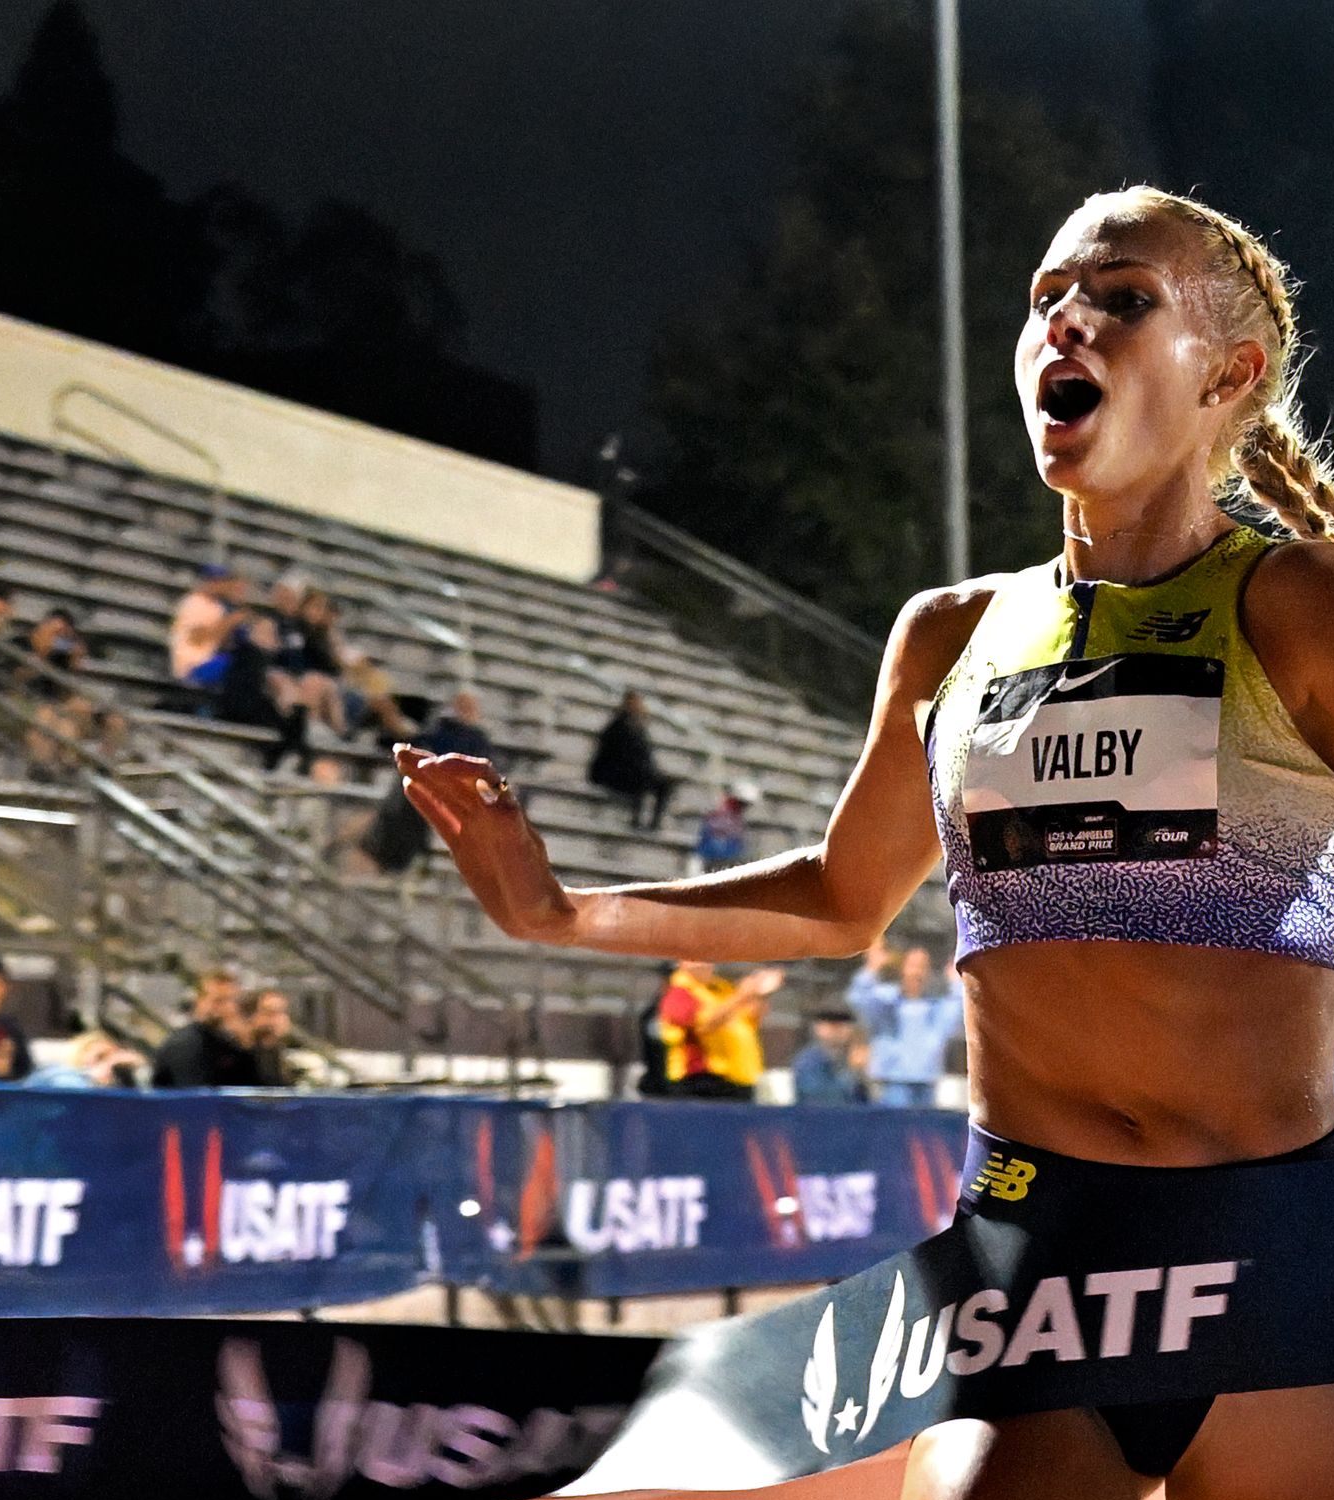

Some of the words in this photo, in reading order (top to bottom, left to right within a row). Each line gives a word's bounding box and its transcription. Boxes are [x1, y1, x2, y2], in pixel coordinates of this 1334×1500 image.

[1031, 728, 1143, 783] VALBY
[1048, 831, 1065, 842] LOS
[1075, 829, 1114, 841] ANGELES
[1049, 841, 1086, 852] GRAND
[1088, 839, 1113, 850] PRIX
[1154, 831, 1189, 843] TOUR
[220, 1178, 351, 1261] USATF
[568, 1175, 707, 1253] USATF
[799, 1172, 878, 1241] USATF
[901, 1260, 1237, 1398] USATF
